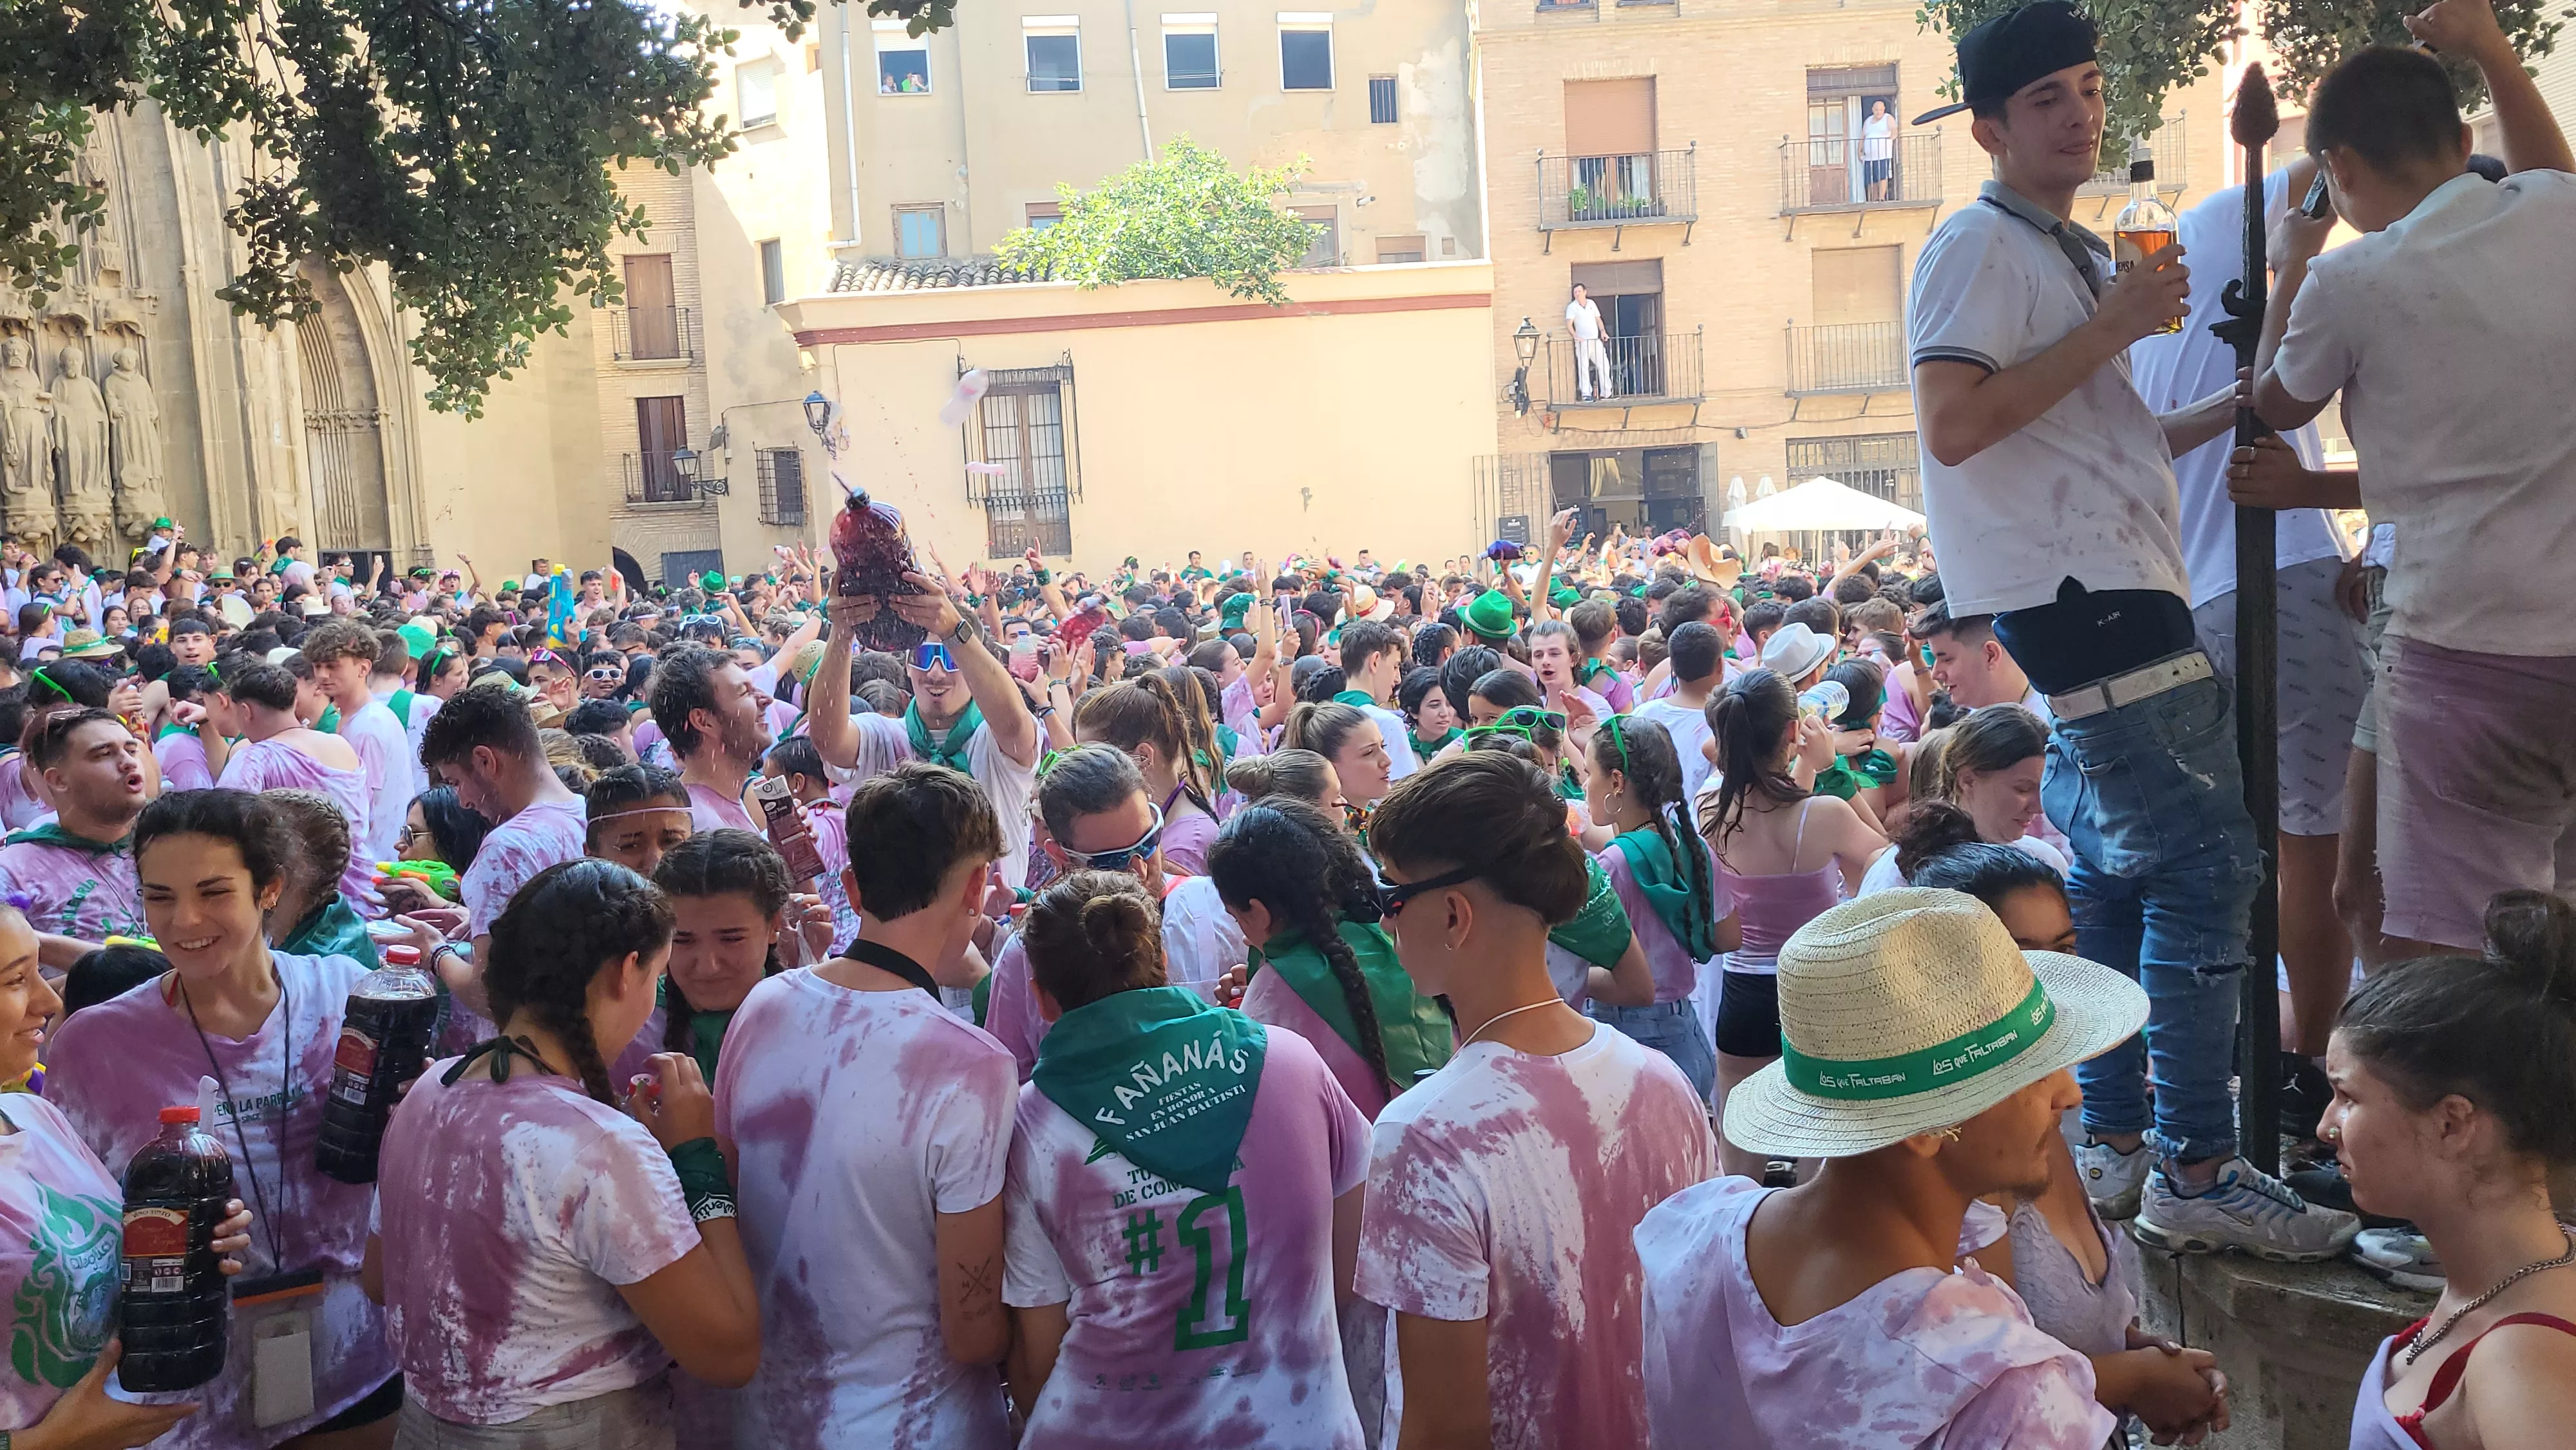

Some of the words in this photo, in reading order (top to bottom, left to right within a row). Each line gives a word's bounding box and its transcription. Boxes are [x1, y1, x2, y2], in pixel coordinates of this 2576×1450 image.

[1954, 1053, 1969, 1069] QUE
[1964, 1029, 2018, 1064] FALTABAN
[1094, 1030, 1249, 1125] FAÑANÁS
[1159, 1081, 1202, 1106] FIESTAS
[1837, 1077, 1850, 1089] QUE
[1847, 1072, 1907, 1089] FALTABAN
[239, 1098, 254, 1113] LA
[1125, 1126, 1151, 1142] SAN
[1153, 1110, 1186, 1133] JUAN
[1187, 1084, 1247, 1117] BAUTISTA
[1150, 1109, 1166, 1121] EN
[1167, 1089, 1206, 1113] HONOR
[1208, 1086, 1217, 1095] A
[1113, 1189, 1137, 1209] DE
[1141, 1178, 1180, 1200] CON
